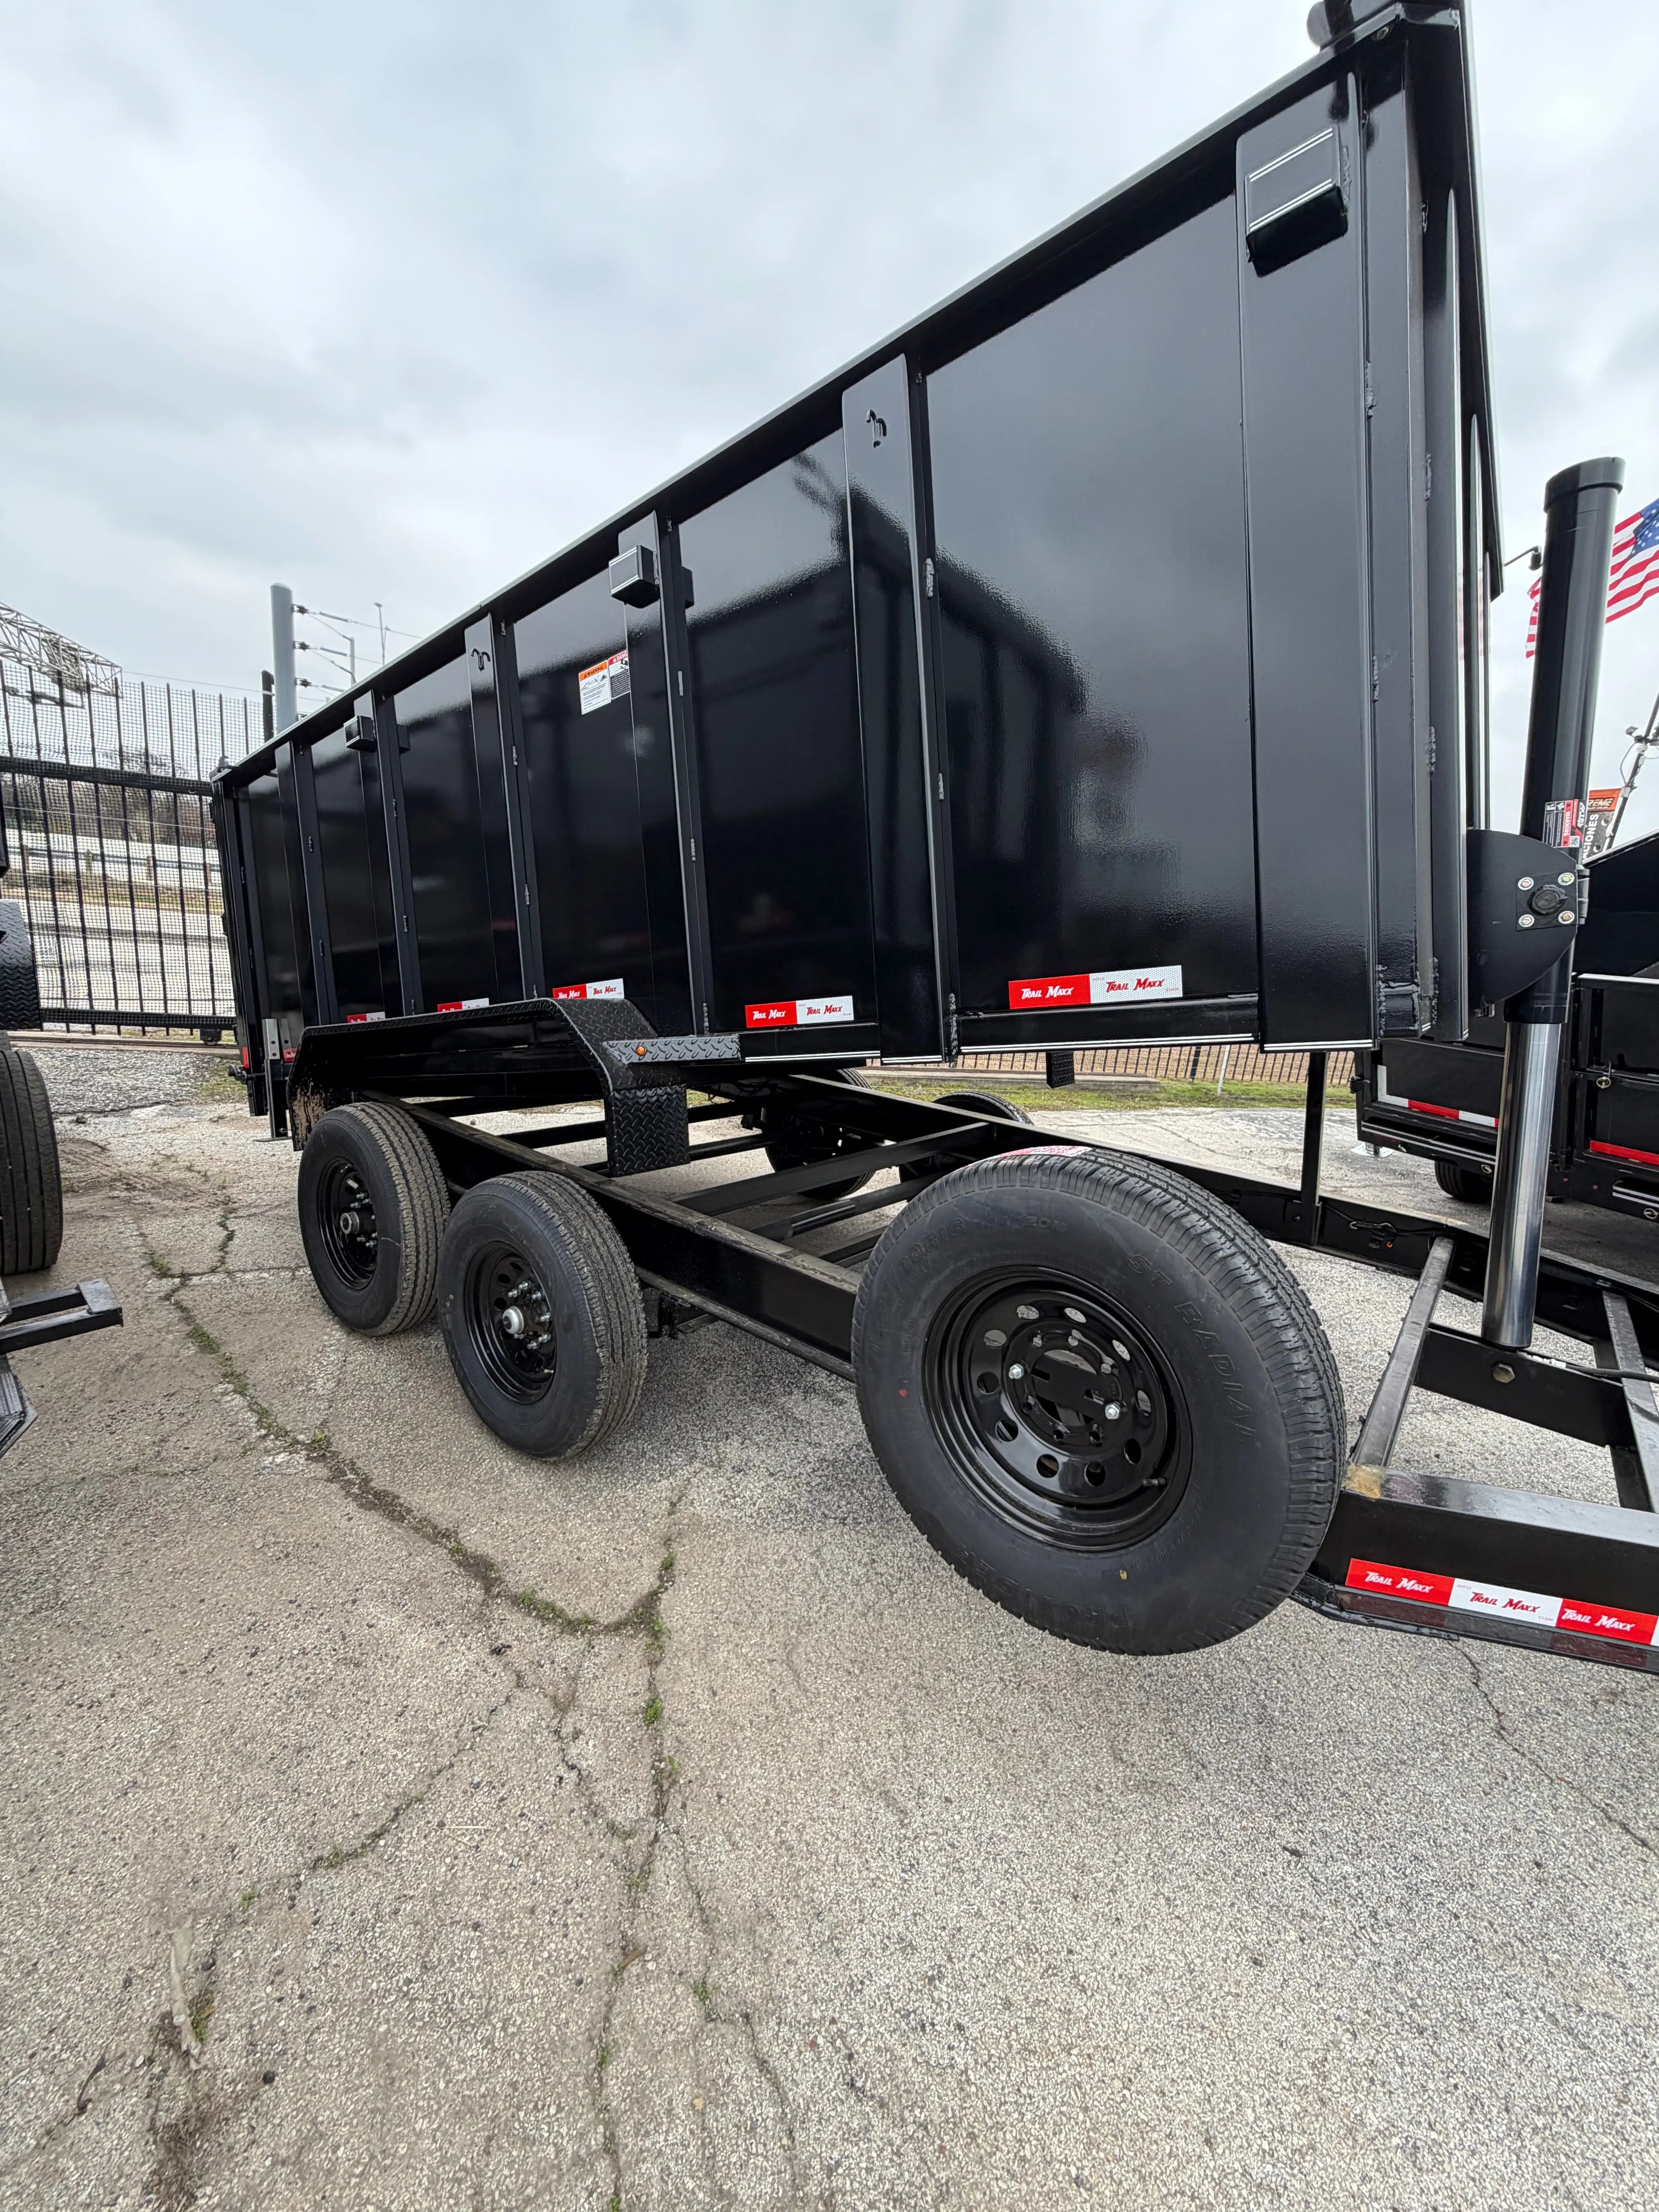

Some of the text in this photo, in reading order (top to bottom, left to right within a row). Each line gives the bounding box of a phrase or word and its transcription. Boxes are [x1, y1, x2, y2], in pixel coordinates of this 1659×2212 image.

[587, 665, 603, 675] WARNING
[1128, 1254, 1257, 1442] ST RADIAL
